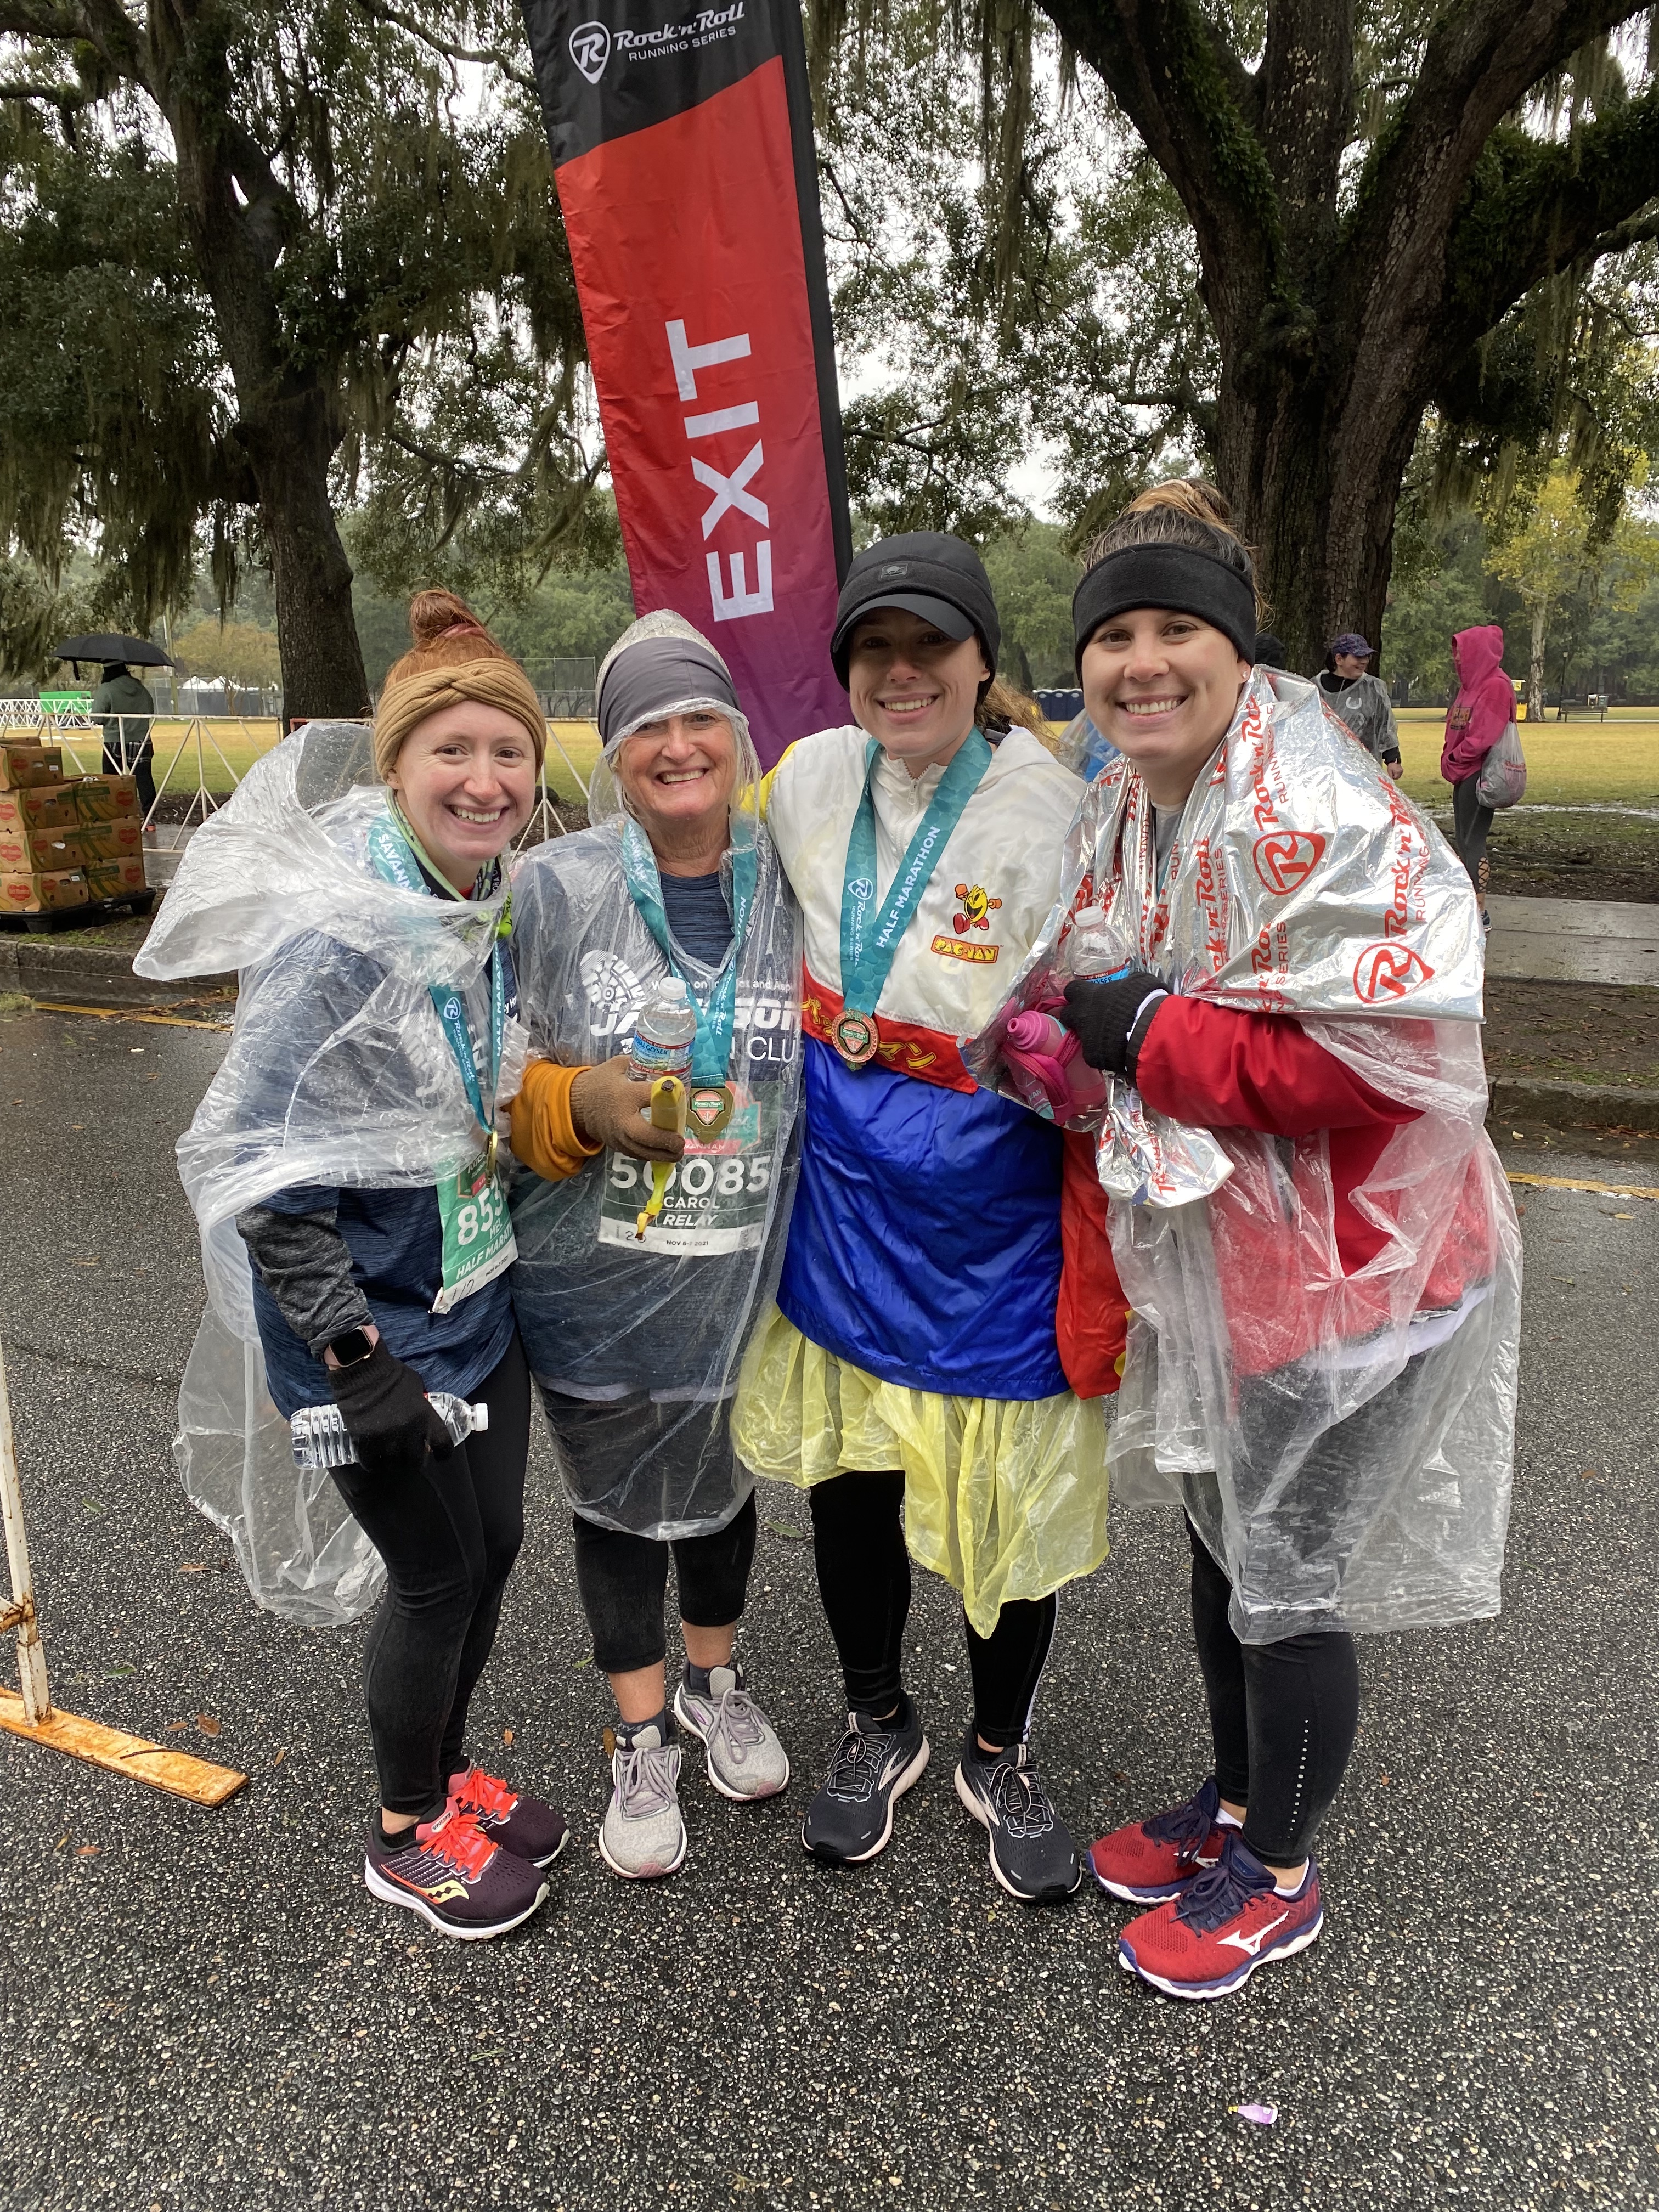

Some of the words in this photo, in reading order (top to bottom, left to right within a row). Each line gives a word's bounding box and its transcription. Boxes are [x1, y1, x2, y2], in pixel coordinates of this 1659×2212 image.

[628, 40, 689, 61] RUNNING
[692, 26, 736, 48] SERIES
[665, 319, 774, 622] EXIT
[876, 909, 899, 948] HALF
[895, 826, 940, 909] MARATHON
[934, 939, 995, 961] PAC-MAN
[1276, 922, 1288, 985] SERIES
[752, 979, 771, 989] and
[646, 1045, 668, 1055] GEYSER
[747, 1036, 795, 1063] CLU
[610, 1152, 771, 1196] 50085
[663, 1196, 720, 1209] CAROL
[490, 1218, 503, 1239] MEL
[663, 1214, 719, 1227] RELAY
[456, 1250, 484, 1280] HALF
[432, 1812, 452, 1831] saucony
